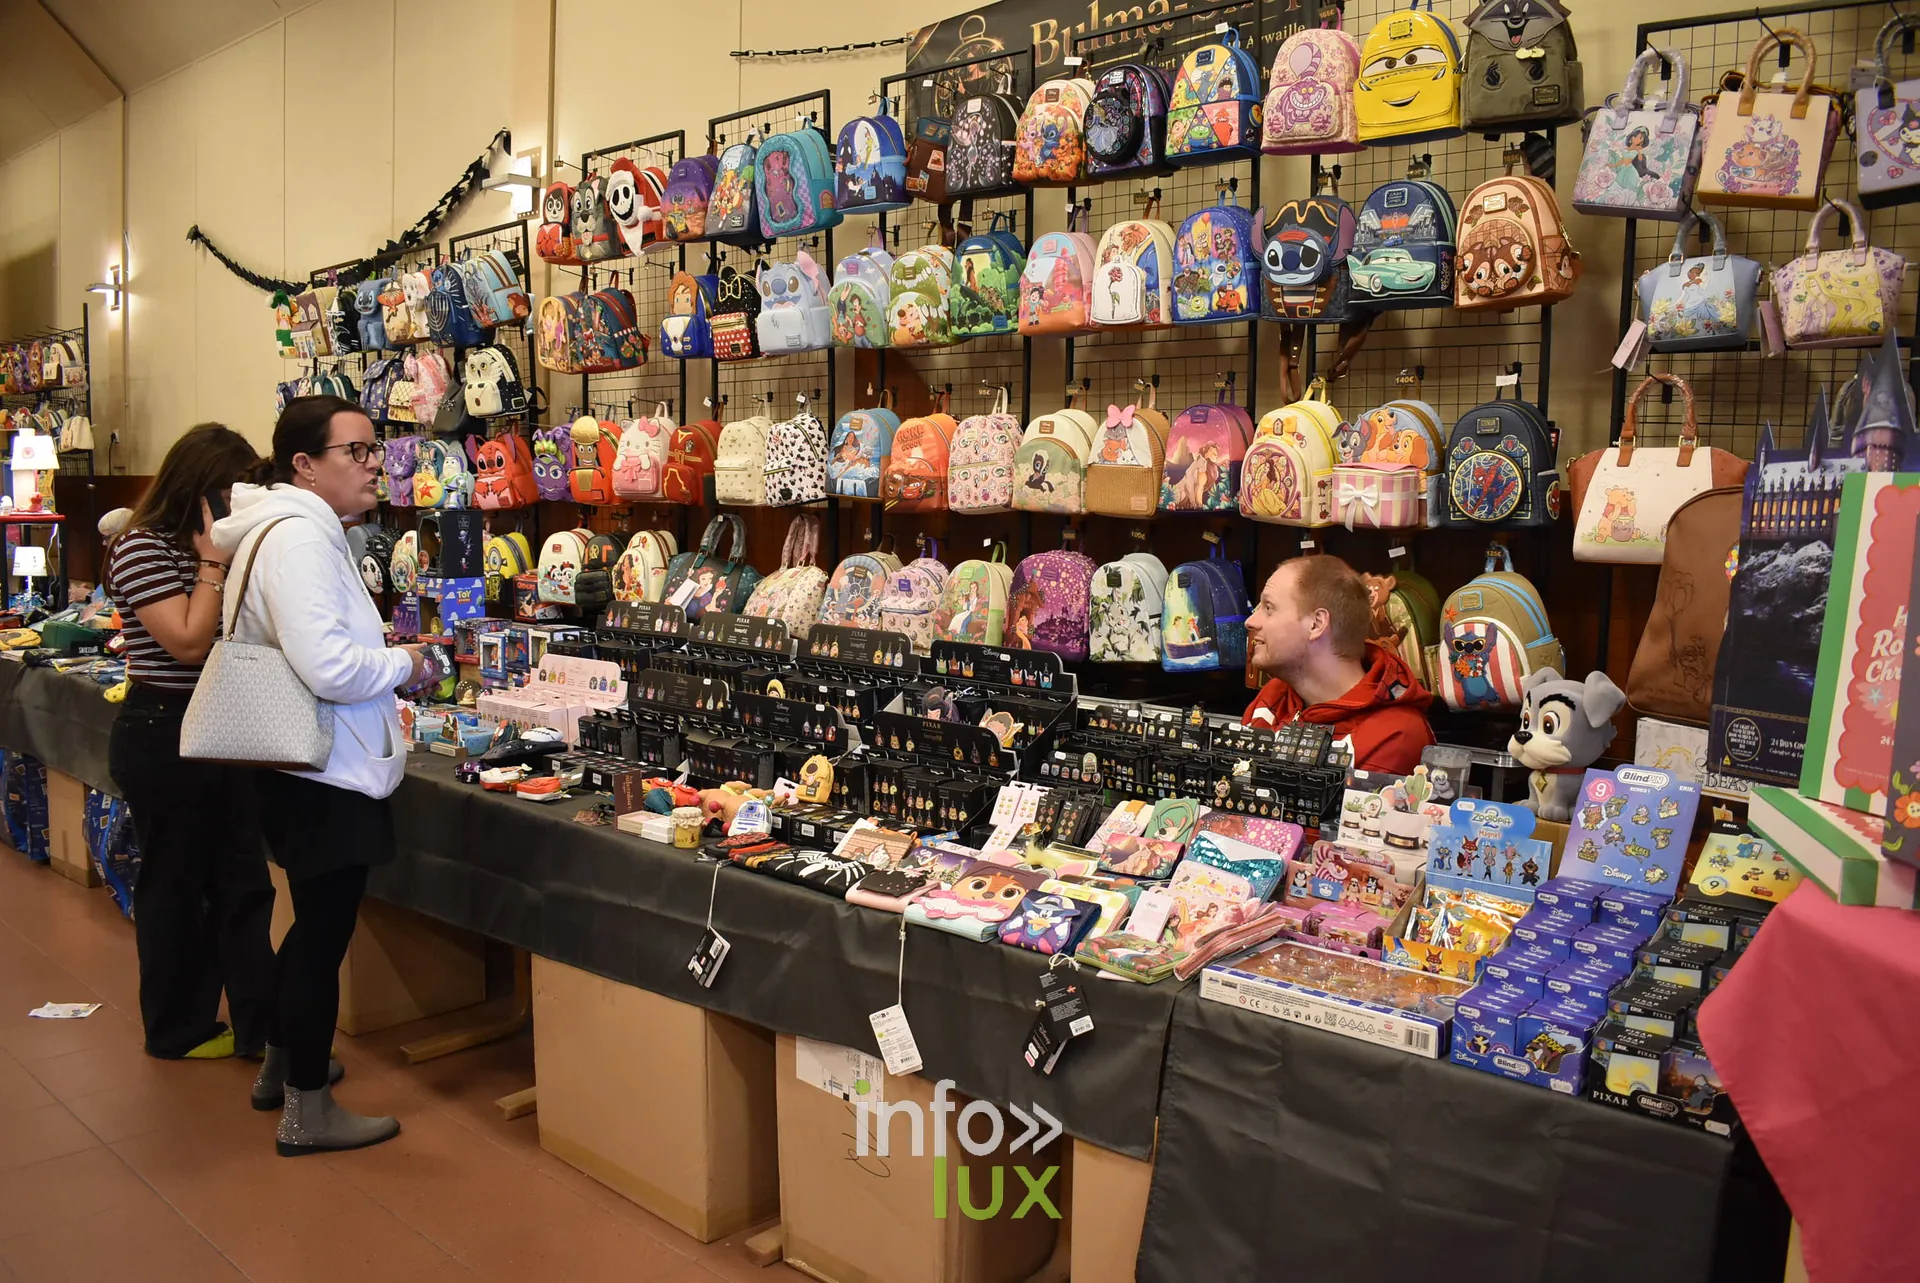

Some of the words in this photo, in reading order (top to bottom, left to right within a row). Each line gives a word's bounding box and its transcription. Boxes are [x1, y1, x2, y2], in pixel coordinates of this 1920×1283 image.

[1245, 23, 1306, 49] Awaille
[1395, 376, 1415, 384] 140€
[457, 590, 471, 598] TOY
[1871, 629, 1904, 657] Ro
[981, 646, 1000, 658] Disney
[922, 721, 941, 729] PIXAR
[1595, 782, 1607, 798] 9
[1602, 864, 1632, 884] Disney
[1709, 880, 1720, 890] 9
[1615, 914, 1640, 929] Disney
[1500, 980, 1525, 994] Disney
[1652, 1012, 1673, 1020] PIXAR
[1471, 1021, 1496, 1038] Disney
[1543, 1021, 1570, 1036] Disney
[1454, 1049, 1479, 1066] Disney
[1637, 1050, 1657, 1059] PIXAR
[1593, 1091, 1629, 1107] PIXAR
